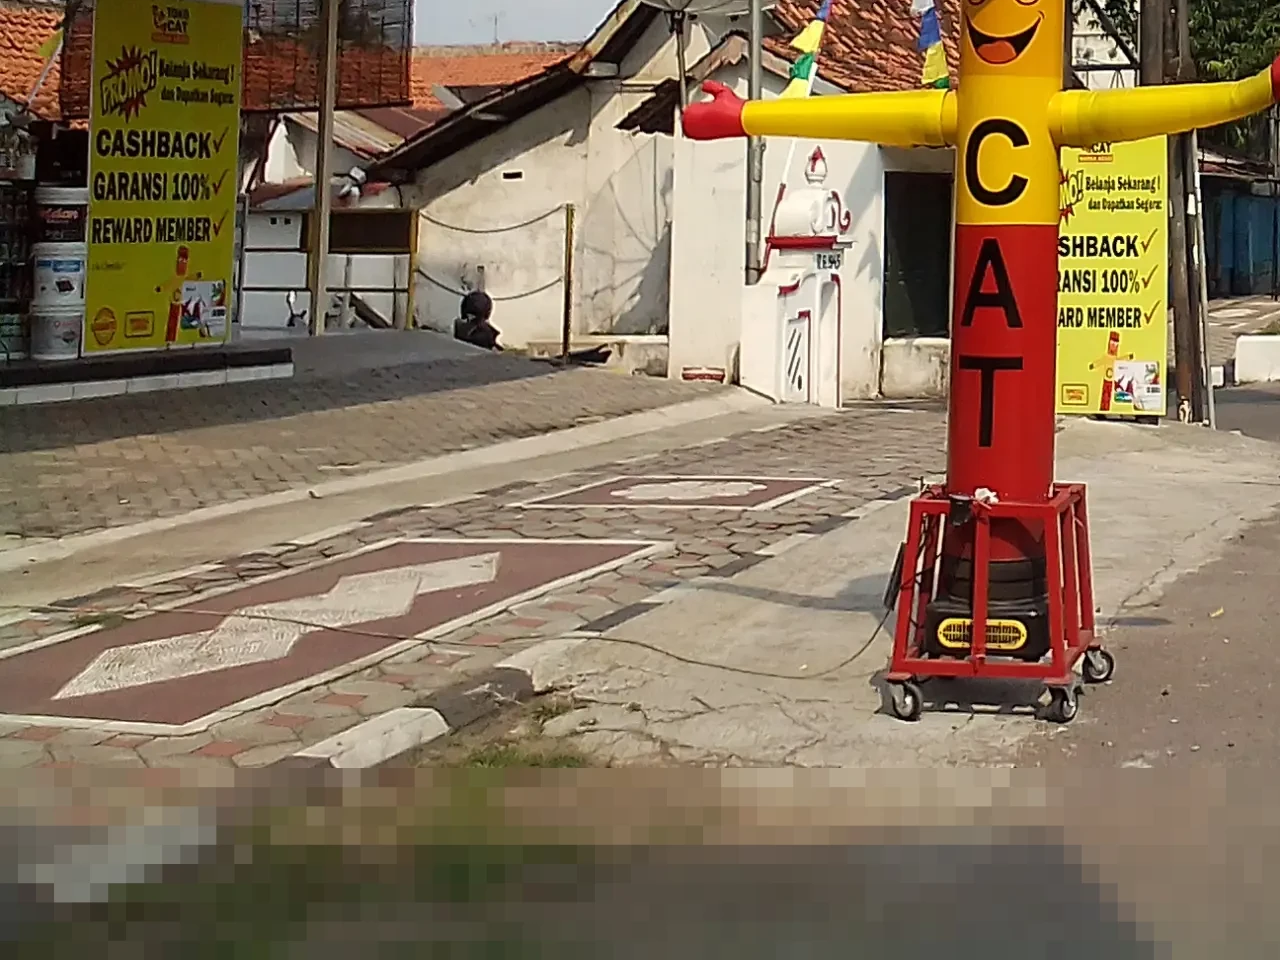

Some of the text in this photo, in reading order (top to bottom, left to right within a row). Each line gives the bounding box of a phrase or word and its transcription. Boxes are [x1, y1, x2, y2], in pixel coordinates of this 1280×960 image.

[167, 20, 189, 33] CAT
[96, 128, 212, 159] CASHBACK
[93, 171, 210, 201] GARANSI 100%
[92, 217, 211, 243] REWARD MEMBER
[1058, 235, 1139, 257] SHBACK
[1058, 269, 1140, 293] ANSI 100%
[1058, 307, 1141, 328] ARD MEMBER
